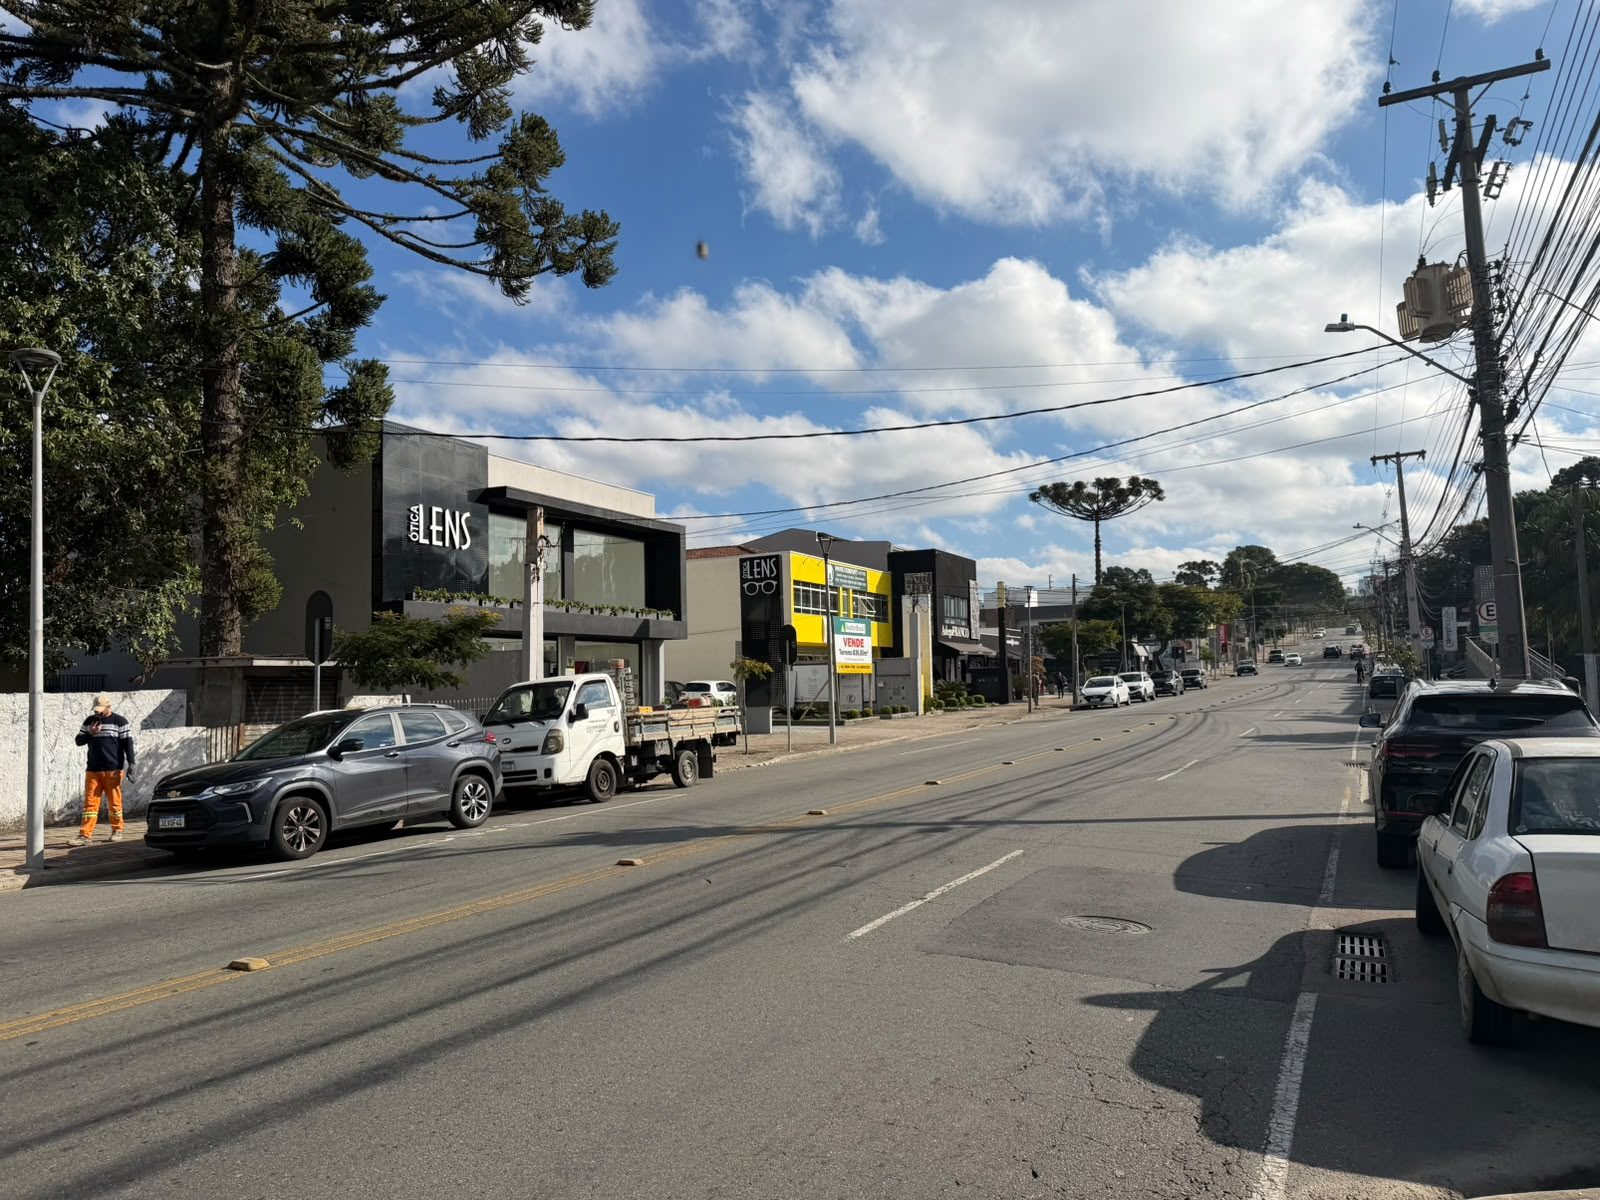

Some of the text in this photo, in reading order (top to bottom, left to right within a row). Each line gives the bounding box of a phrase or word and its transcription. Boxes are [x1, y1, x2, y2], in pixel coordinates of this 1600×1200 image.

[408, 505, 419, 542] ÓTICA
[418, 503, 471, 551] LENS
[747, 557, 777, 579] LENS
[1486, 604, 1496, 617] E
[843, 637, 865, 648] VENDE
